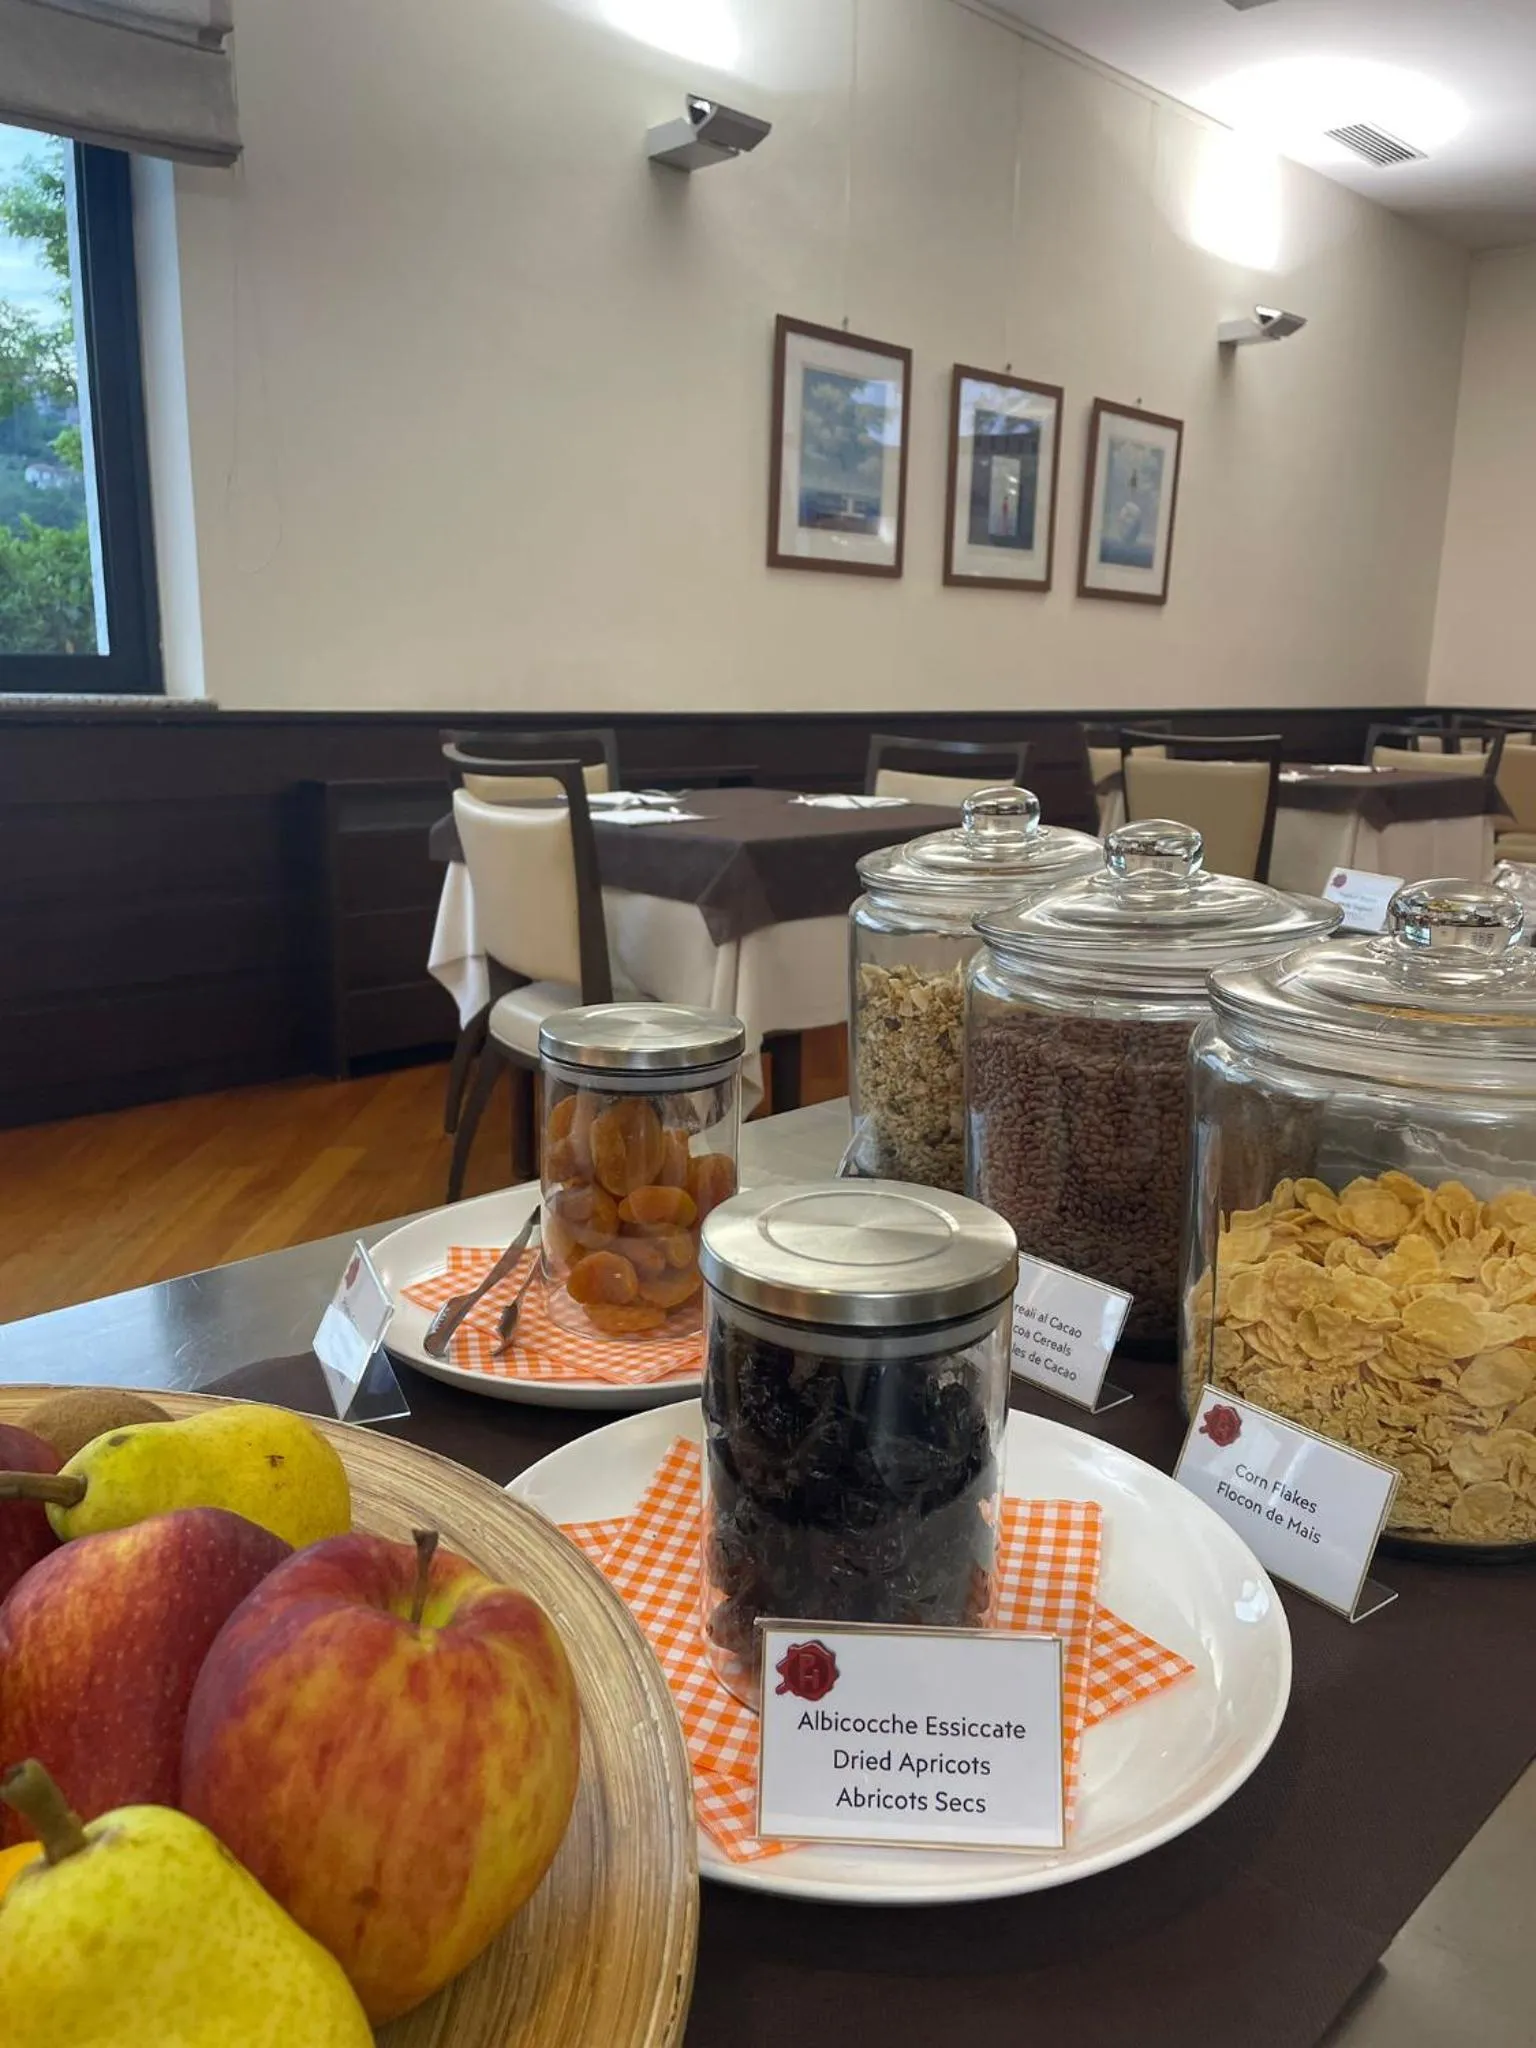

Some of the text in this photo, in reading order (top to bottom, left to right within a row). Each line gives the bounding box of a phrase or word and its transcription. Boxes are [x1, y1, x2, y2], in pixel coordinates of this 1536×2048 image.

[1014, 1303, 1082, 1338] reali al Cacao
[1012, 1324, 1072, 1357] coa Cereals
[1028, 1350, 1041, 1366] de
[1043, 1358, 1077, 1381] Cacao
[1234, 1463, 1318, 1514] Corn Flakes
[1216, 1481, 1321, 1545] Flocon de Mais
[797, 1710, 1027, 1739] Albicocche Essiccate
[833, 1749, 991, 1778] Dried Apricots
[835, 1787, 987, 1813] Abricots Secs
